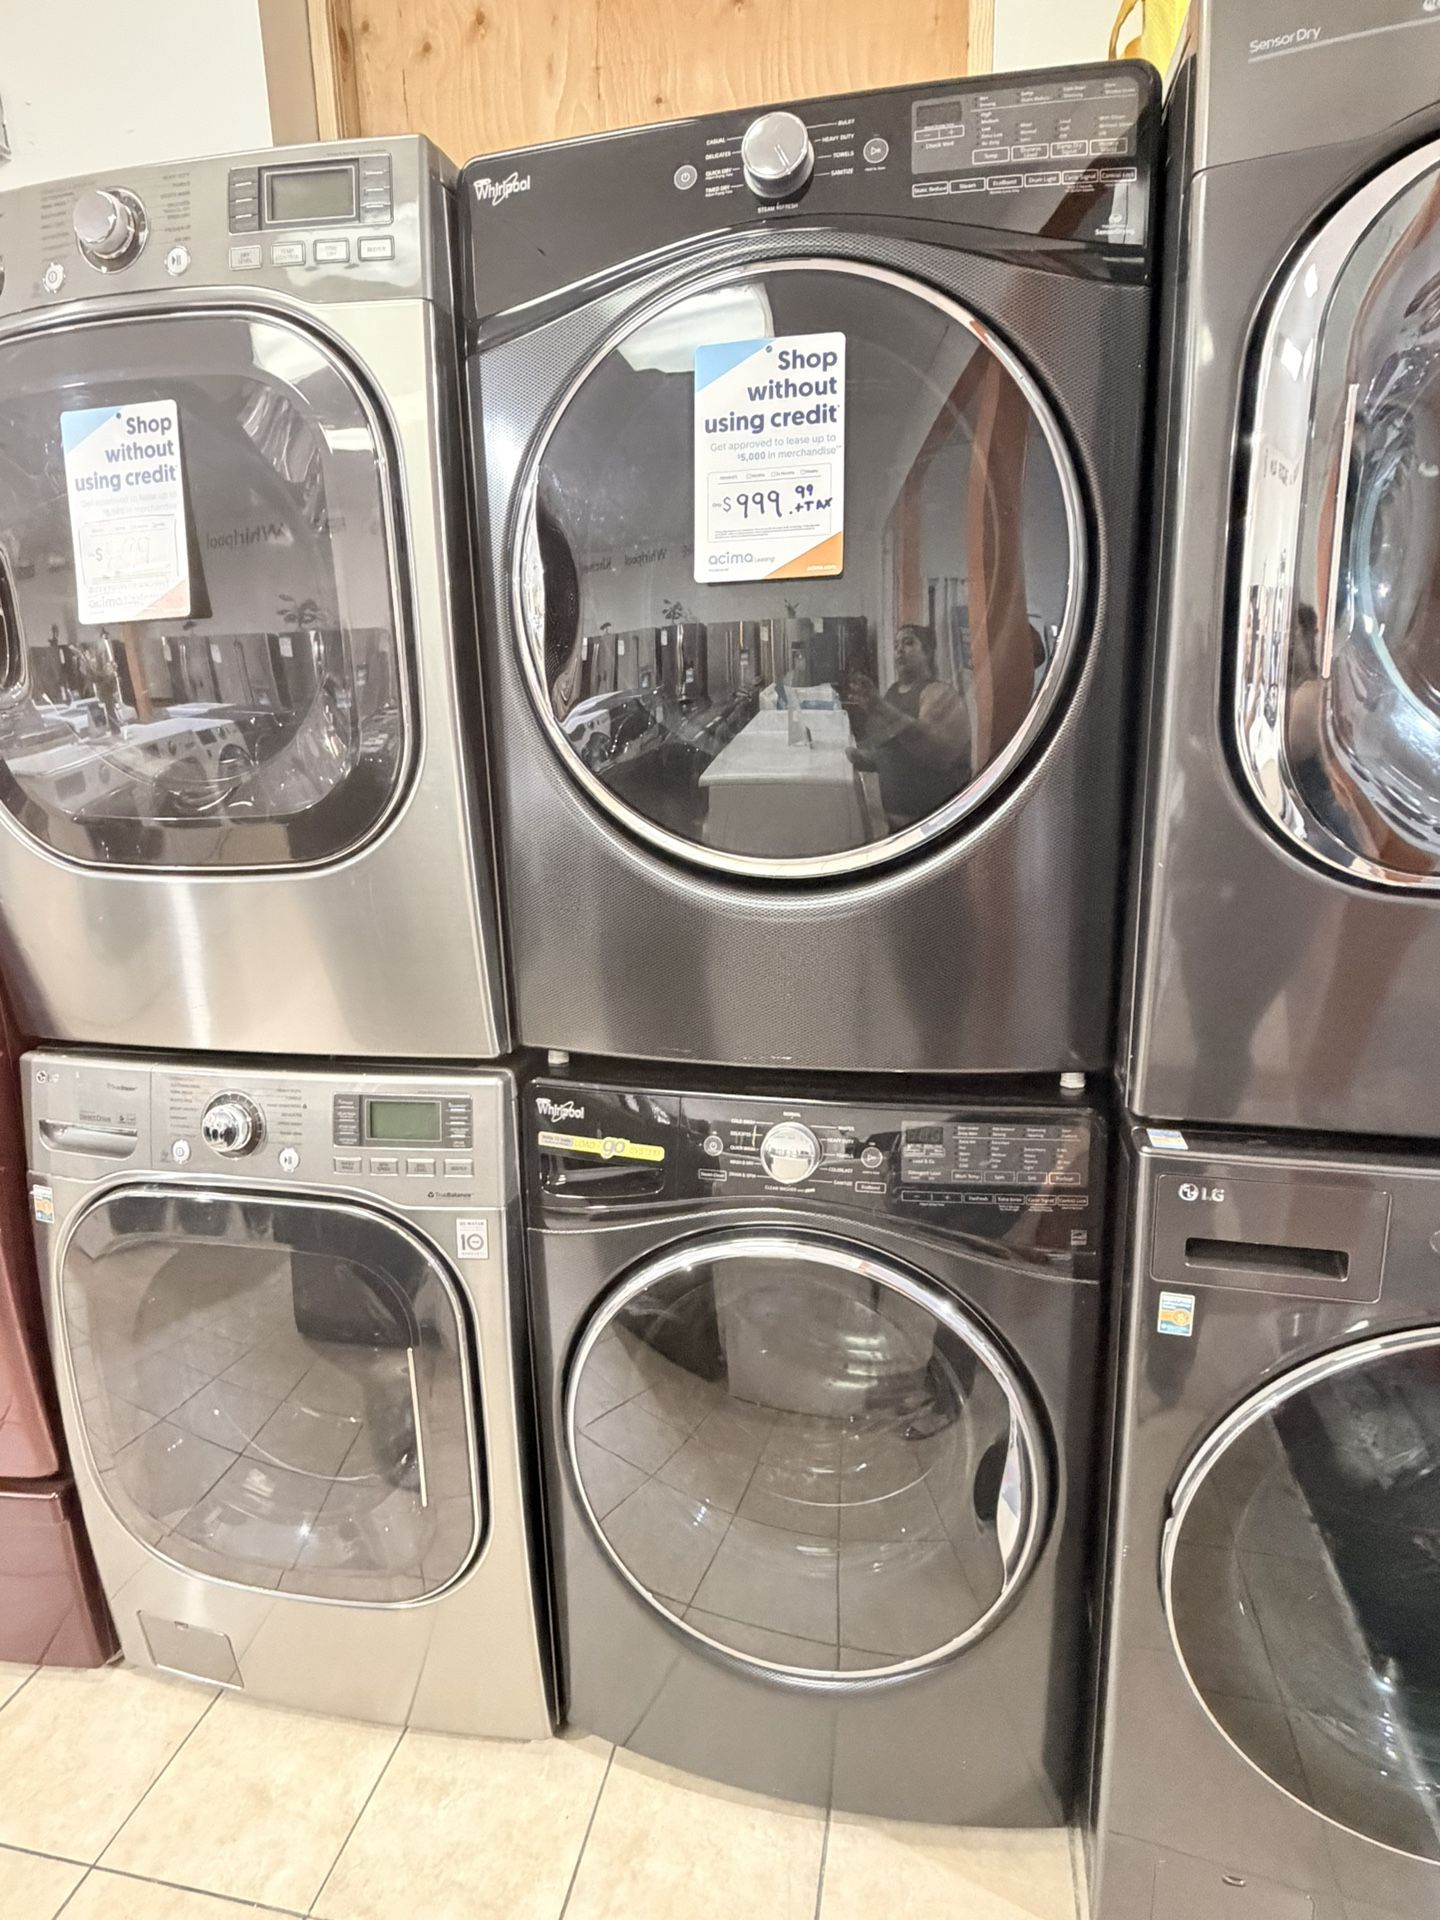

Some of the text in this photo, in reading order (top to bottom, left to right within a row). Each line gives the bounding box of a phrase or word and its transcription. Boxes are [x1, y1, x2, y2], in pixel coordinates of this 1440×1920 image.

[474, 172, 531, 206] Whirlpool
[778, 349, 838, 372] Shop
[748, 377, 837, 402] without
[126, 416, 172, 436] Shop
[705, 412, 764, 434] using
[105, 440, 174, 463] without
[710, 434, 836, 453] Get approved to lease up to
[738, 452, 766, 462] $5,000
[767, 450, 776, 458] in
[75, 464, 176, 492] using credit
[722, 496, 732, 512] $
[708, 552, 753, 566] acima
[536, 1098, 585, 1122] Whirlpool
[603, 1140, 625, 1156] go
[1202, 1187, 1225, 1202] LG
